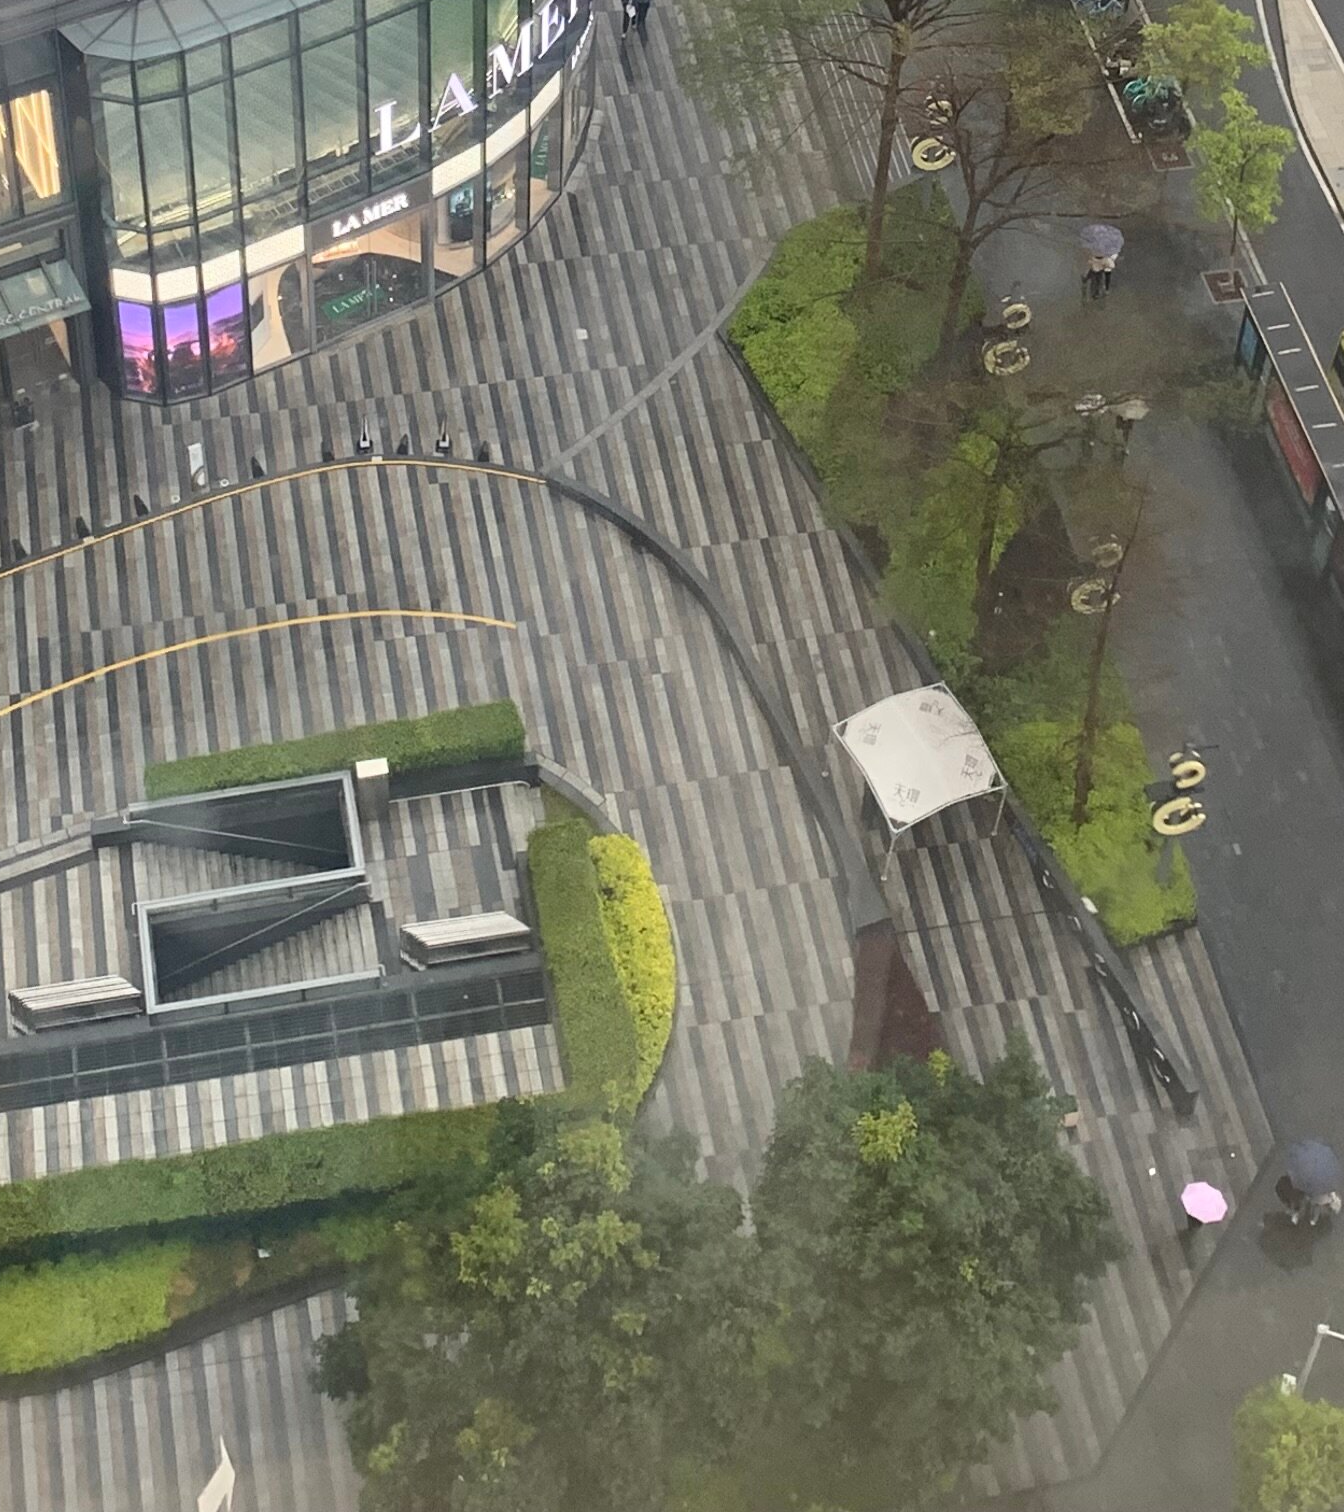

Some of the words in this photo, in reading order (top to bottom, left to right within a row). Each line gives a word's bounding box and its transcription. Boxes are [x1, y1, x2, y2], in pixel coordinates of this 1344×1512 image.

[375, 72, 479, 156] LA
[332, 213, 361, 238] LA
[362, 193, 409, 225] MER
